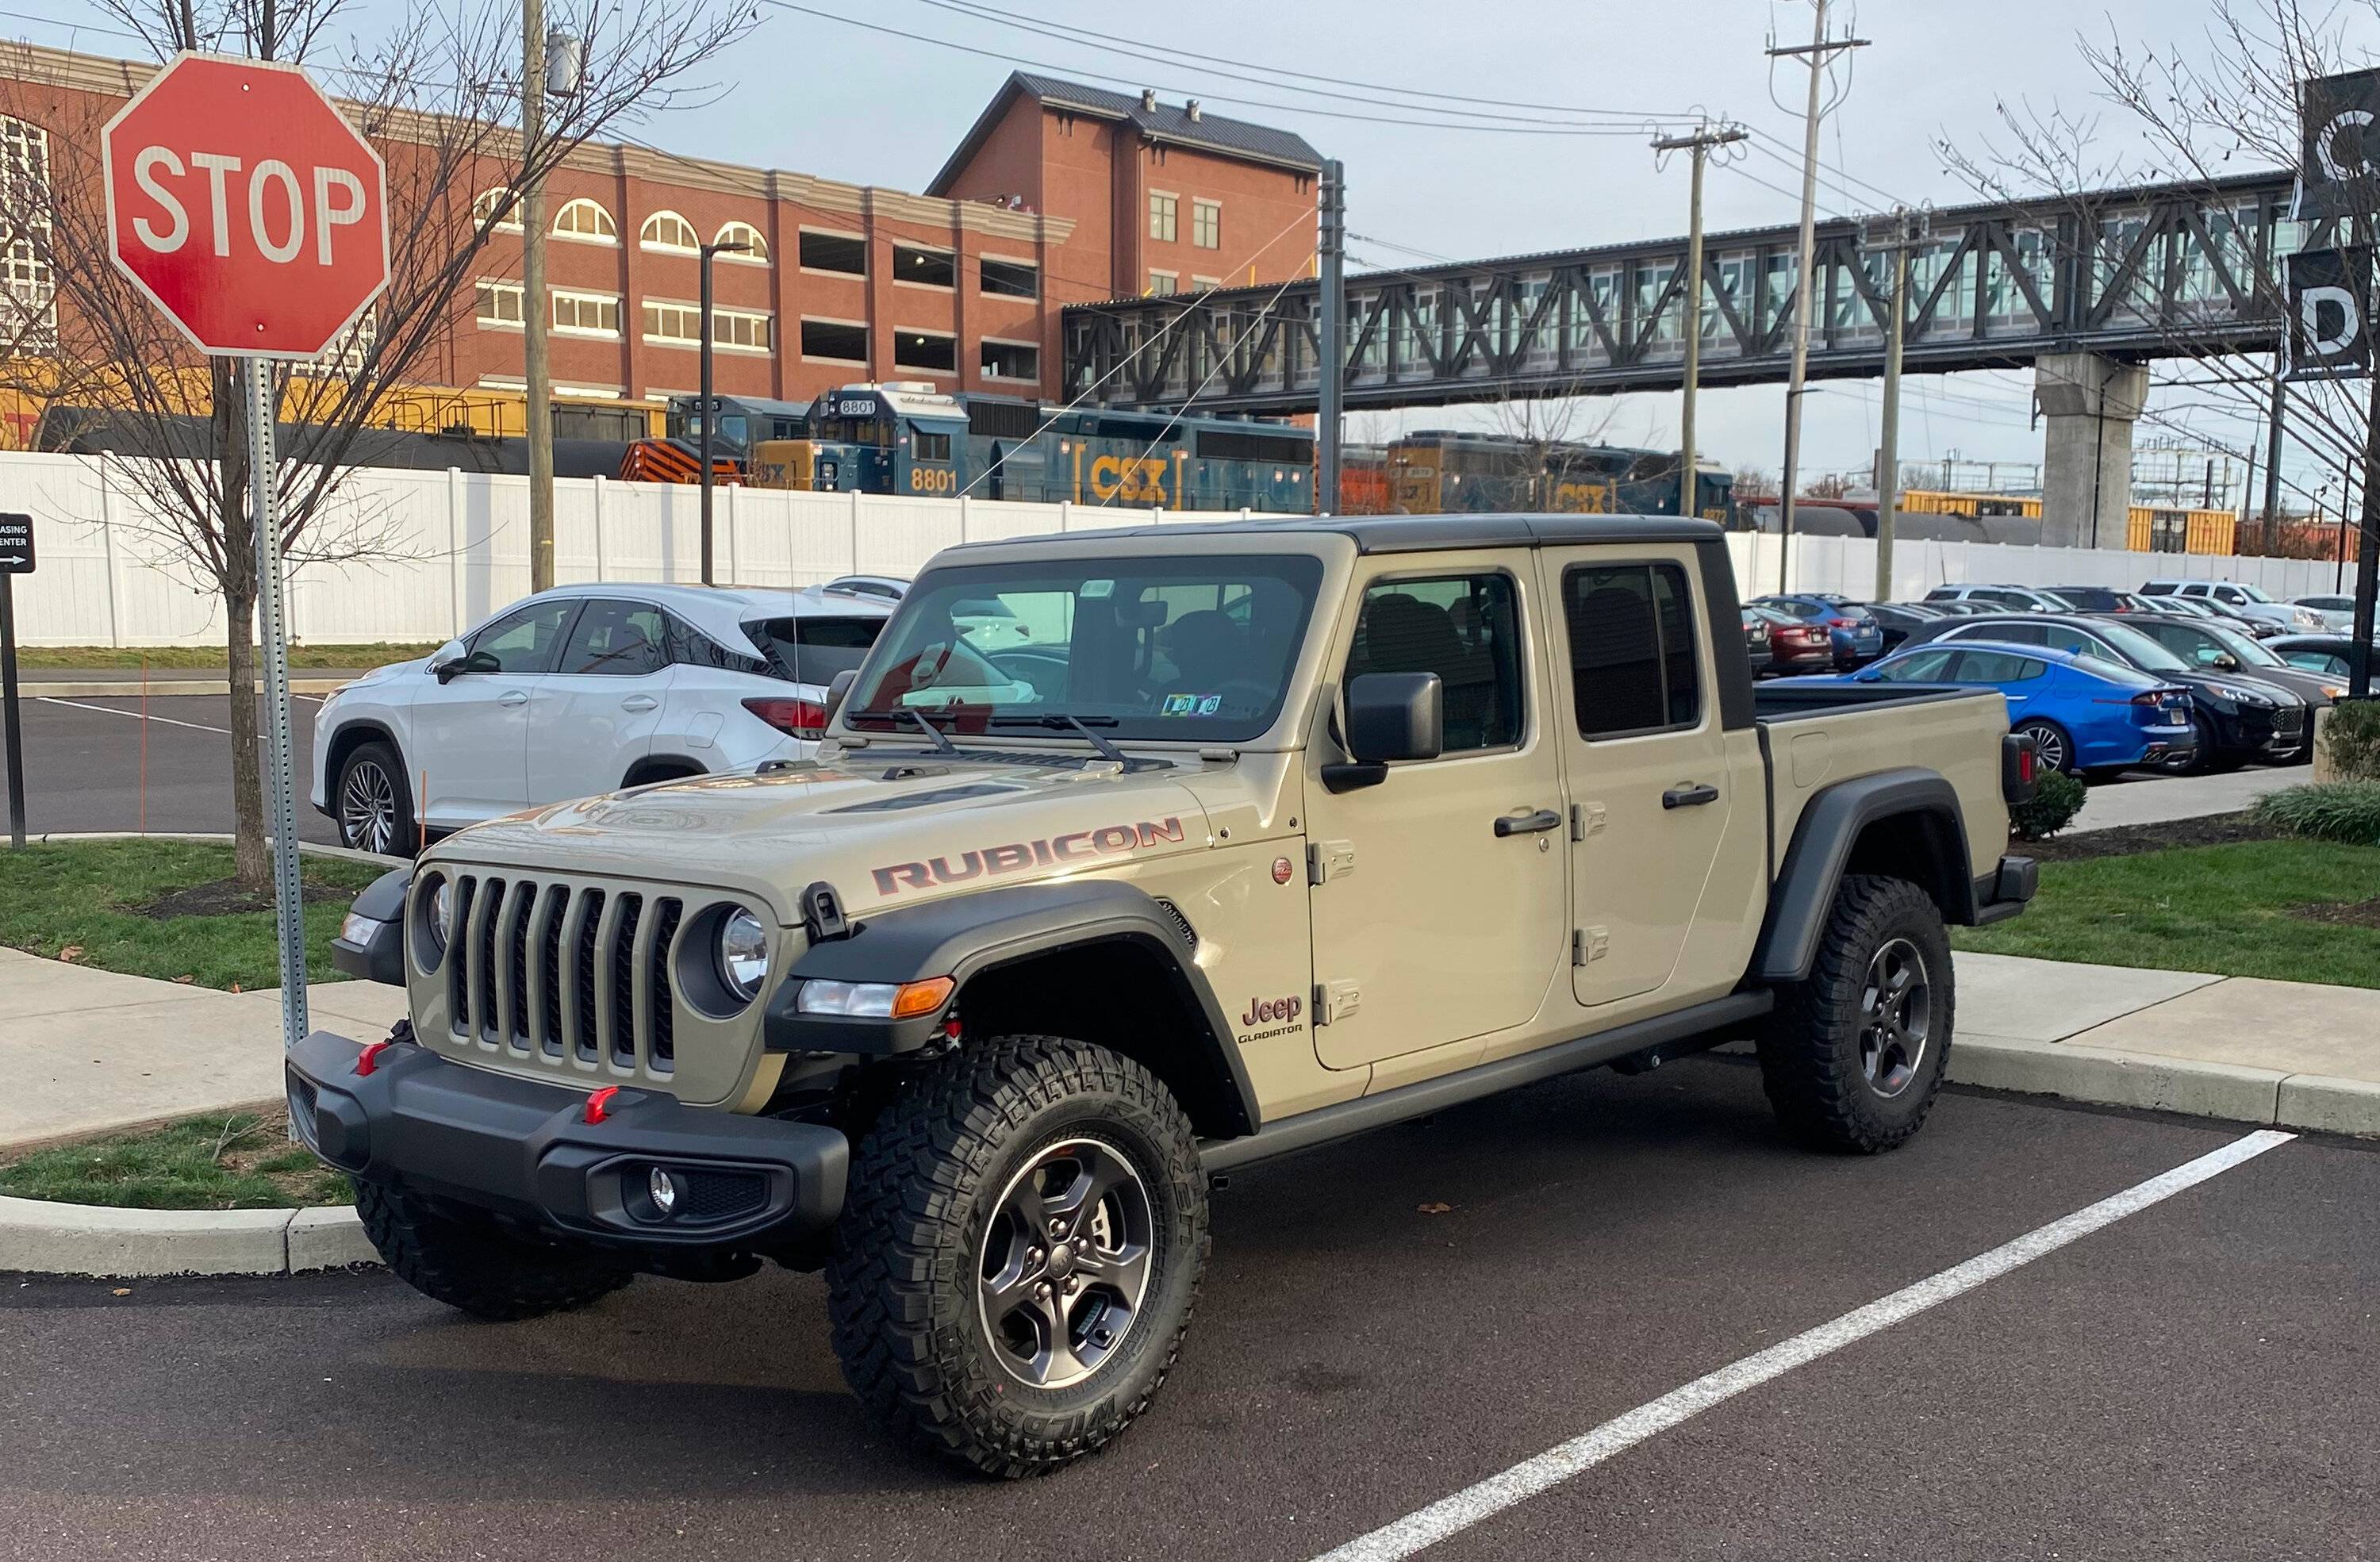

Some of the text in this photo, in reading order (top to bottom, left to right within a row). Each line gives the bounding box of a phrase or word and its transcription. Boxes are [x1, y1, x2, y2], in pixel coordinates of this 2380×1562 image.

[2316, 109, 2374, 181] C
[132, 145, 366, 266] STOP
[2301, 286, 2359, 355] D
[843, 401, 873, 413] 8801
[912, 467, 957, 492] 8801
[1091, 455, 1168, 502] CSX
[0, 526, 27, 535] ASING
[0, 538, 27, 547] ENTER
[871, 817, 1184, 896] RUBICON
[1242, 996, 1302, 1027] Jeep
[1238, 1024, 1303, 1044] GLADIATOR
